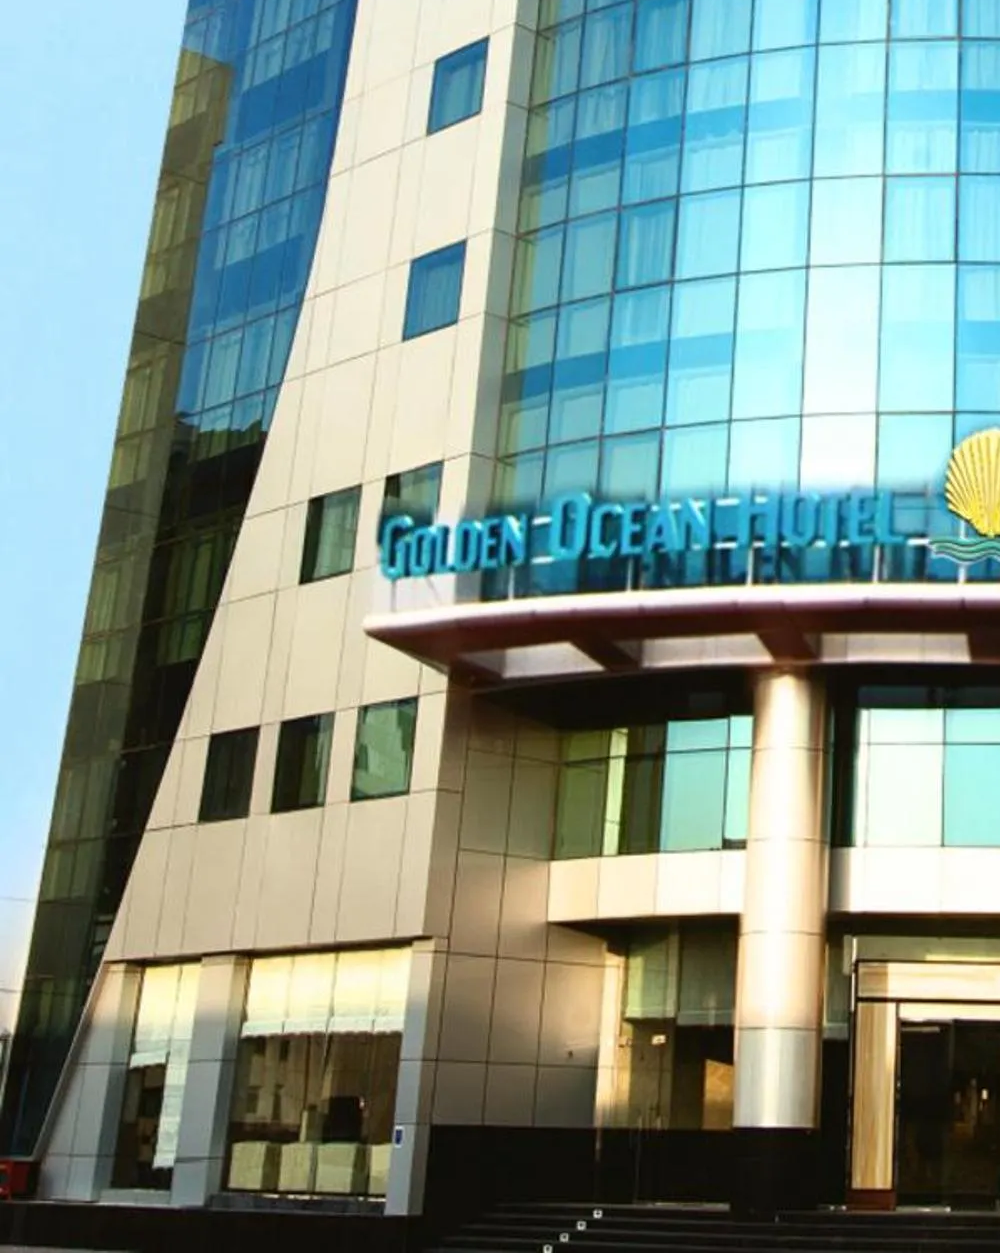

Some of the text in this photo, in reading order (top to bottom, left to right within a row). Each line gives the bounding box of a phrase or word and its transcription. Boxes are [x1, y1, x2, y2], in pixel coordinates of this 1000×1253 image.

[379, 489, 905, 581] GOLDEN OCEAN HOTEL
